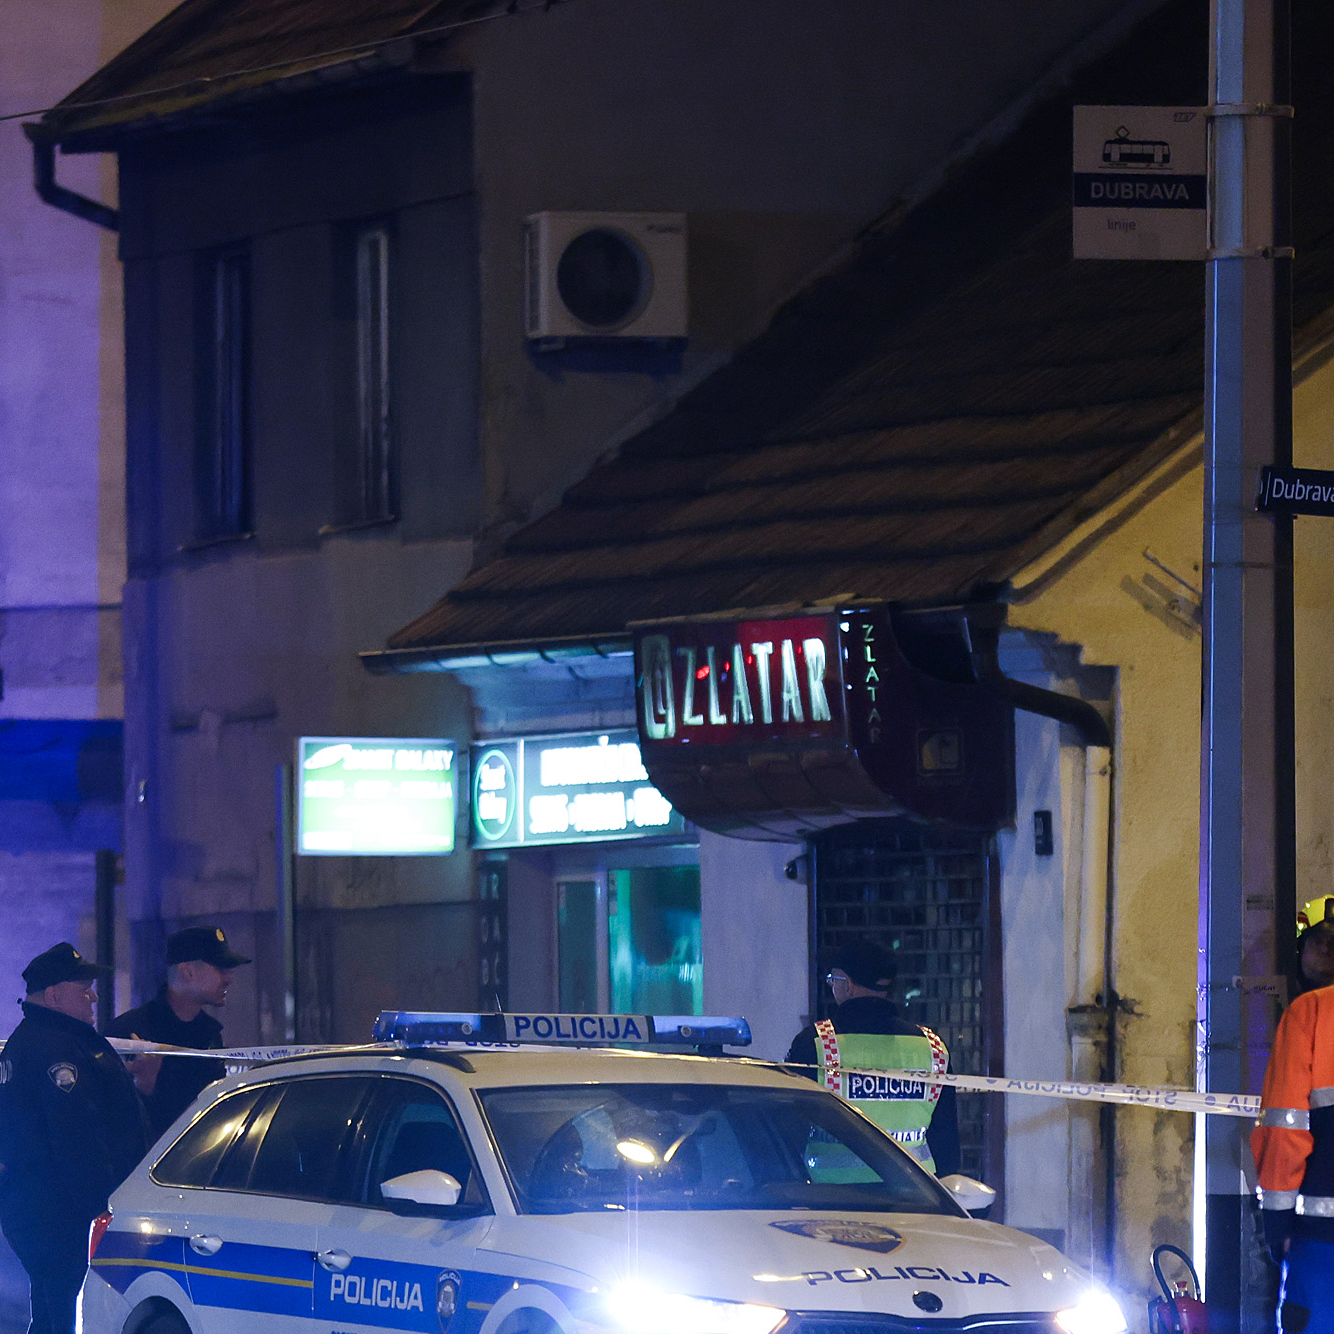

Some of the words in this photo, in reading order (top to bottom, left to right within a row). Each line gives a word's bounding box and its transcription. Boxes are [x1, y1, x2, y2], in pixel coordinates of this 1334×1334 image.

[1091, 182, 1189, 200] DUBRAVA
[1107, 219, 1136, 232] linije
[677, 637, 831, 726] ZLATAR
[515, 1015, 642, 1041] POLICIJA
[852, 1075, 923, 1095] POLICIJA
[802, 1266, 1011, 1287] POLICIJA
[329, 1273, 424, 1312] POLICIJA
